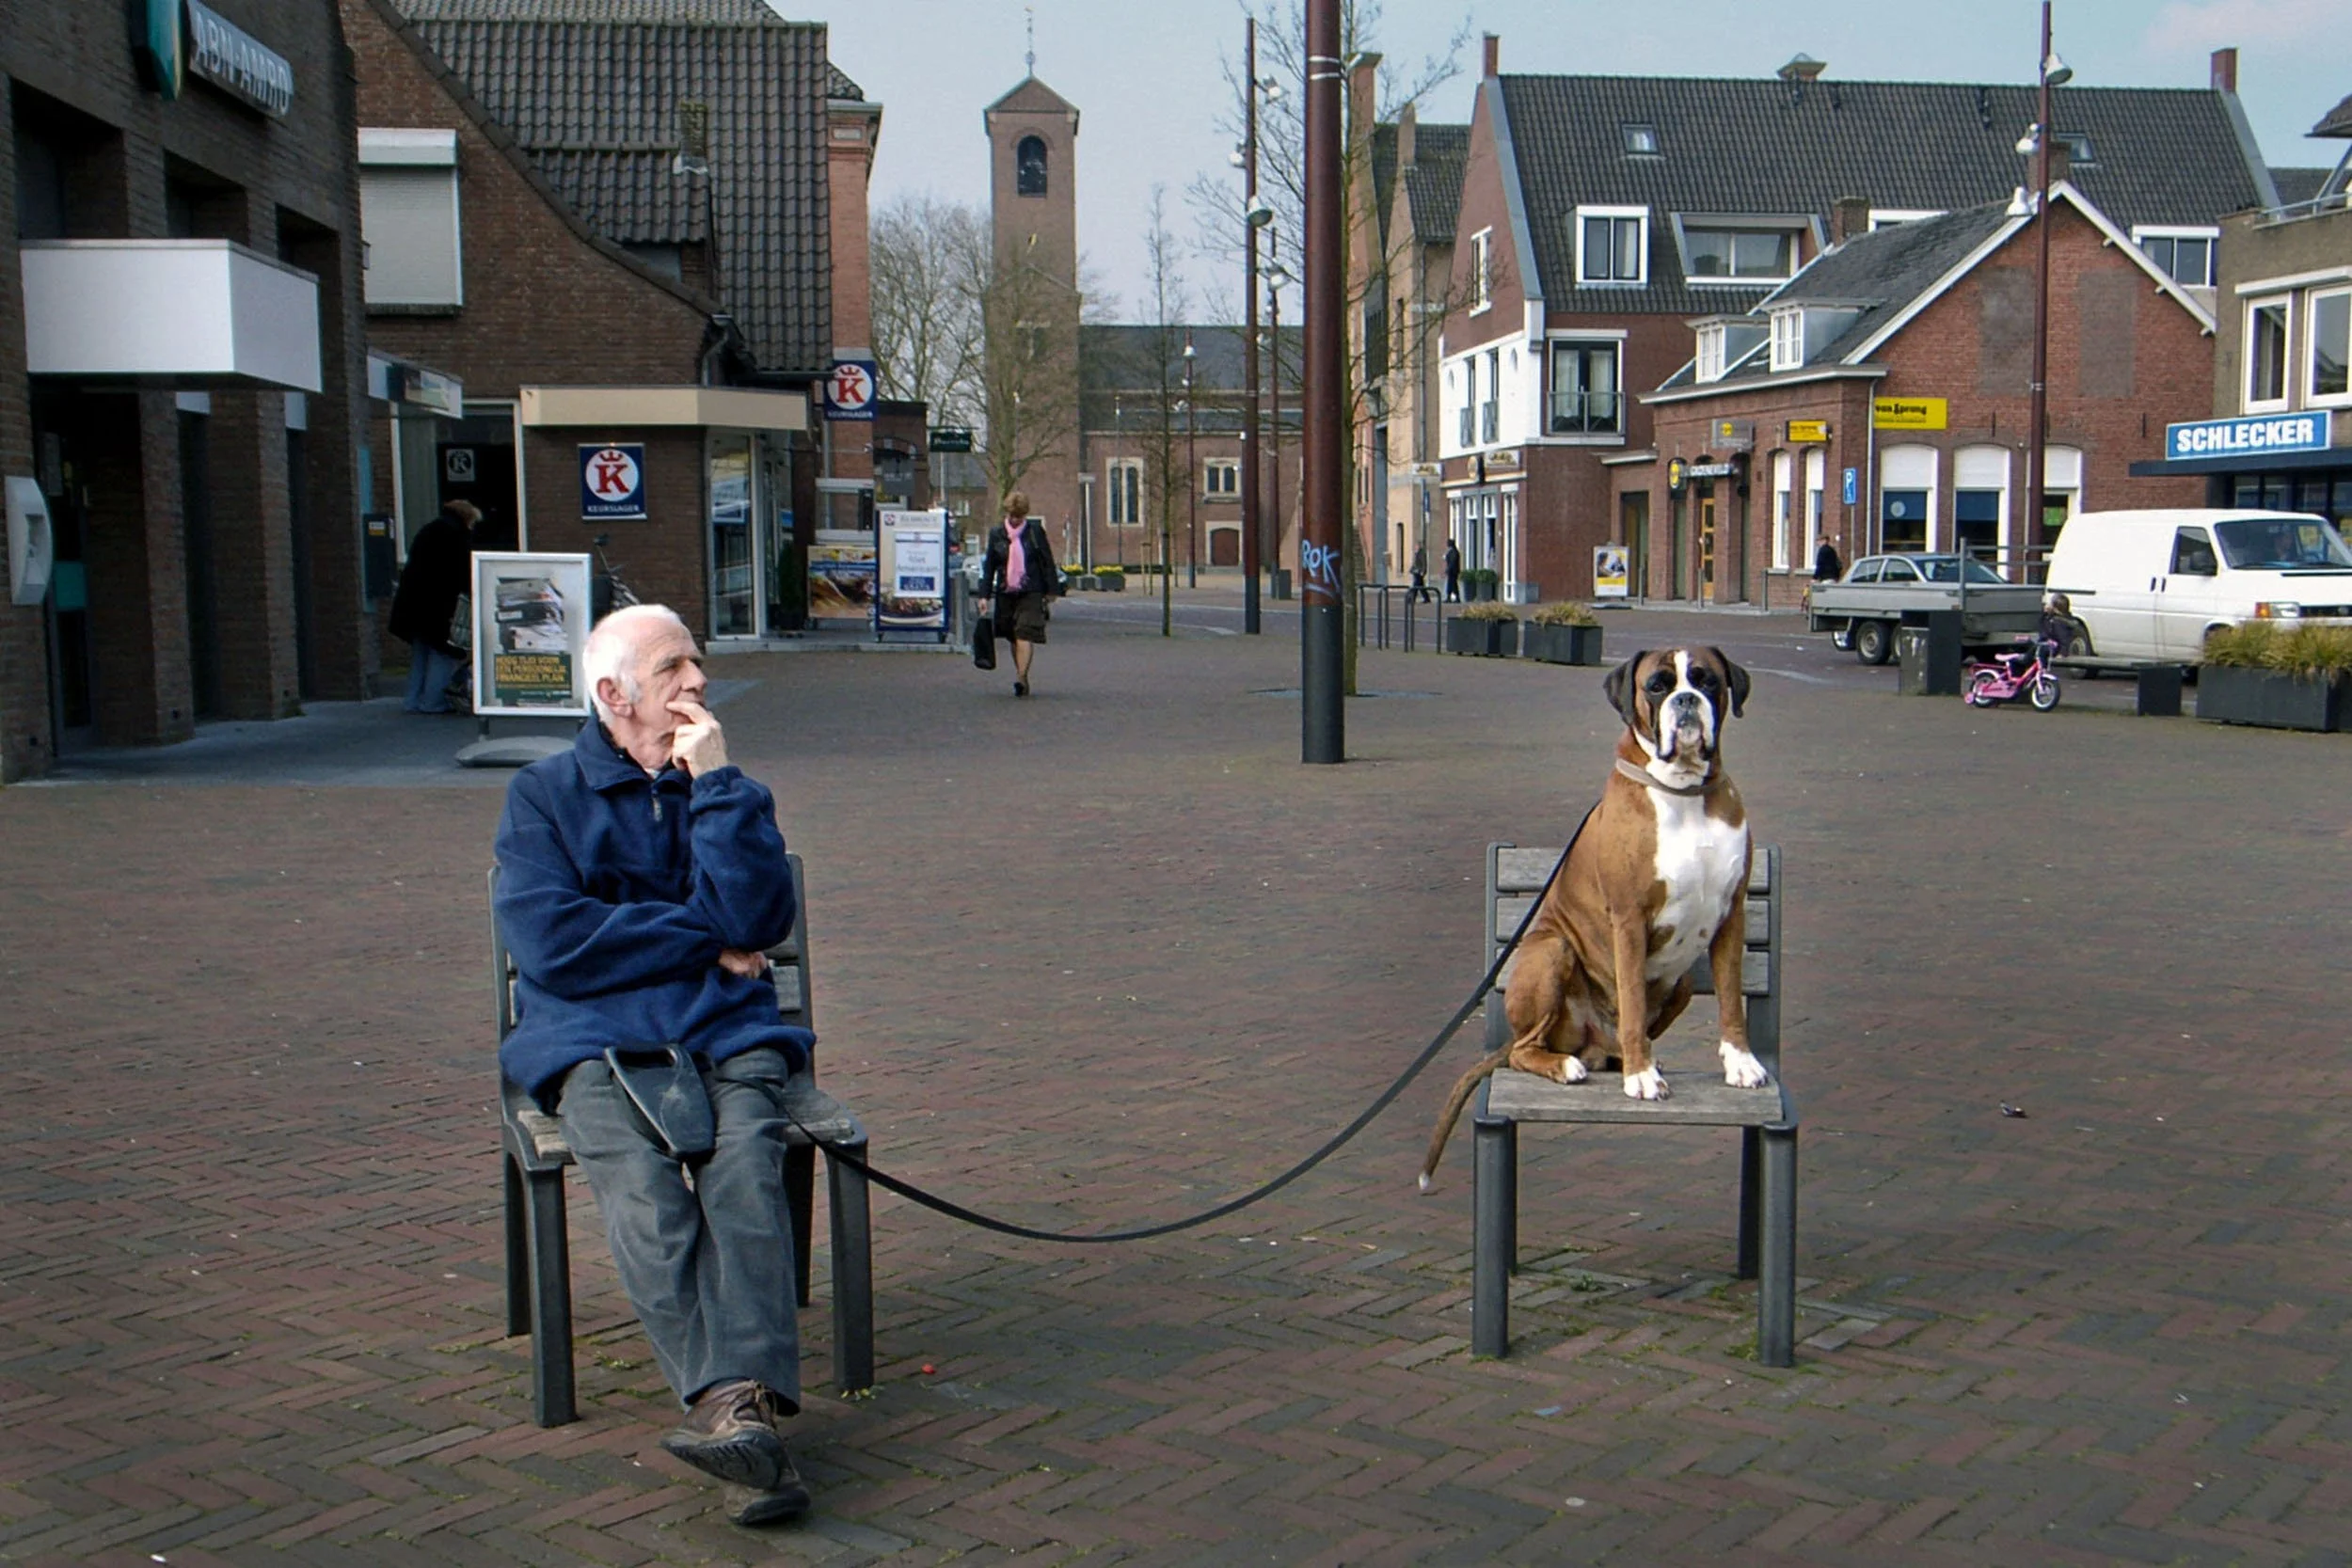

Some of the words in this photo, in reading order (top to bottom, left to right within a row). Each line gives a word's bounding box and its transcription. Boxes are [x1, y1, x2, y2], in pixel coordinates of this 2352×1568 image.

[835, 377, 865, 404] K
[2176, 419, 2314, 452] SCHLECKER
[595, 464, 629, 494] K
